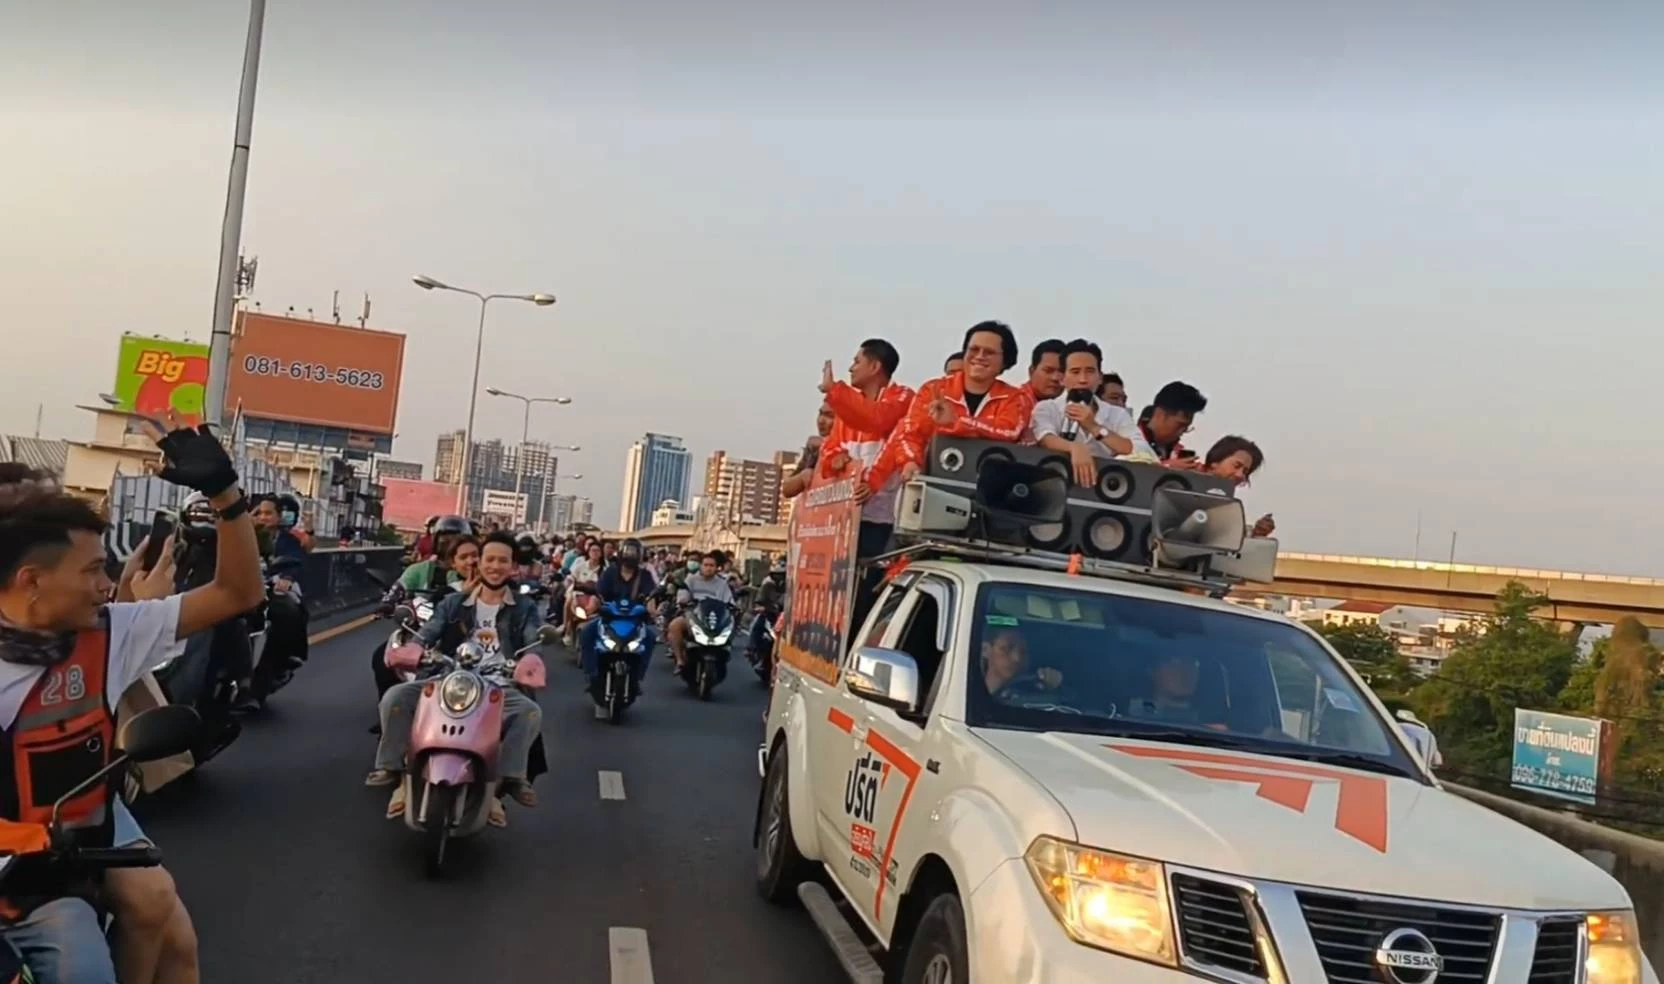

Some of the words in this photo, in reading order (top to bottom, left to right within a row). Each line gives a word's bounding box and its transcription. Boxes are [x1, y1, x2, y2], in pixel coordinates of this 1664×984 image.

[136, 350, 185, 382] Big
[244, 354, 384, 389] 081-613-5623
[40, 664, 86, 705] 28
[1387, 953, 1440, 967] NISSAN
